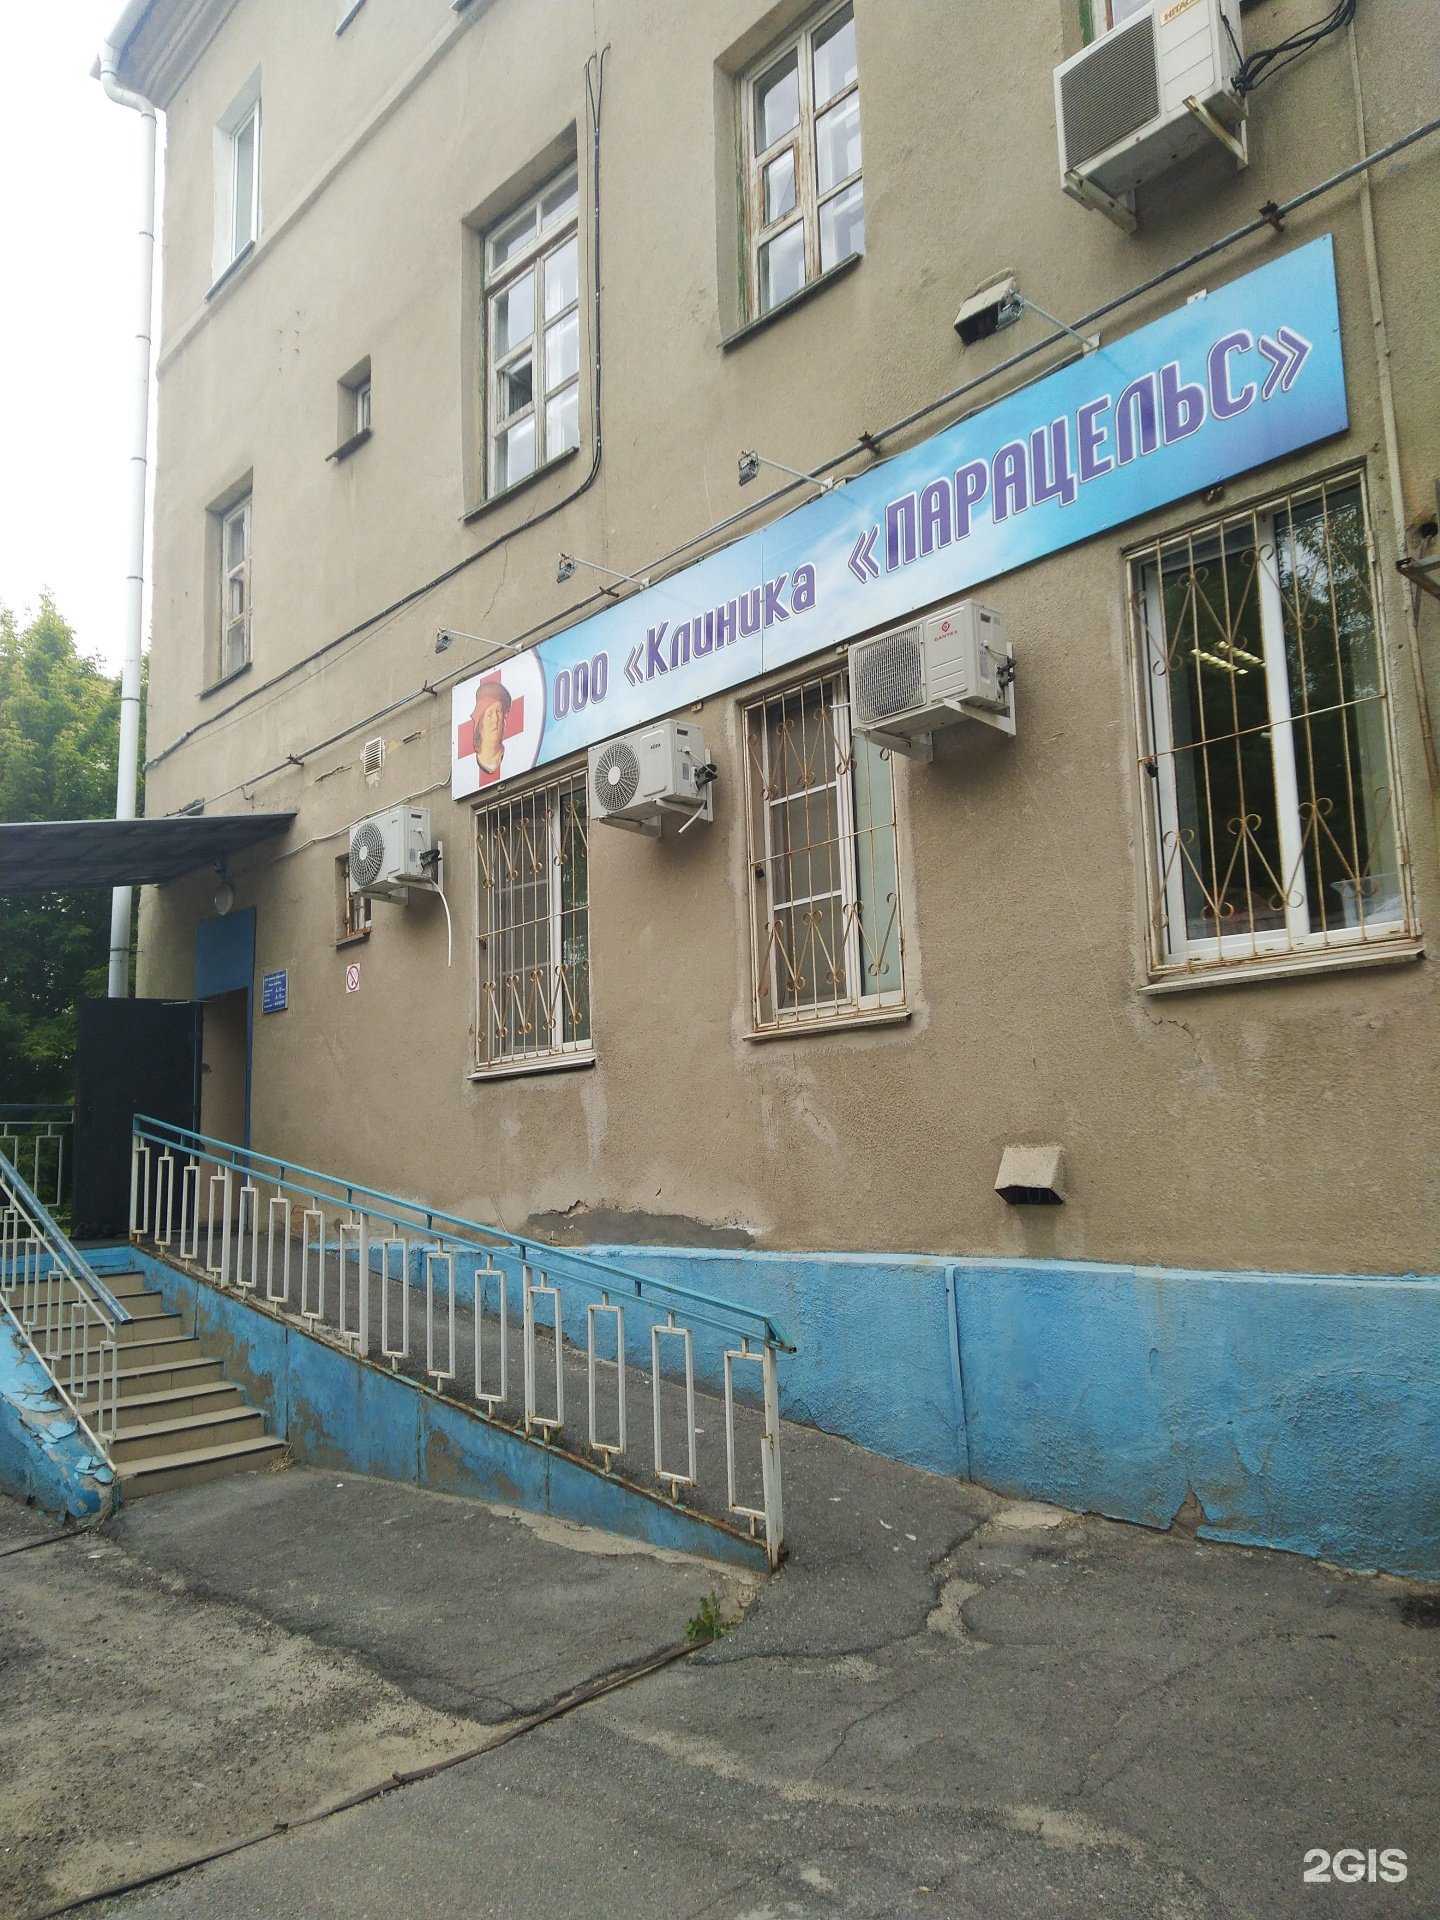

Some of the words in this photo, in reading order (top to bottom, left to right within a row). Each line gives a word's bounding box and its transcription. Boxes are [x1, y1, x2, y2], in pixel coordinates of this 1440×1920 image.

[553, 651, 609, 721] ООО
[623, 562, 817, 687] «Клиника
[847, 326, 1312, 584] «ПАРАЦЕЛЬС»
